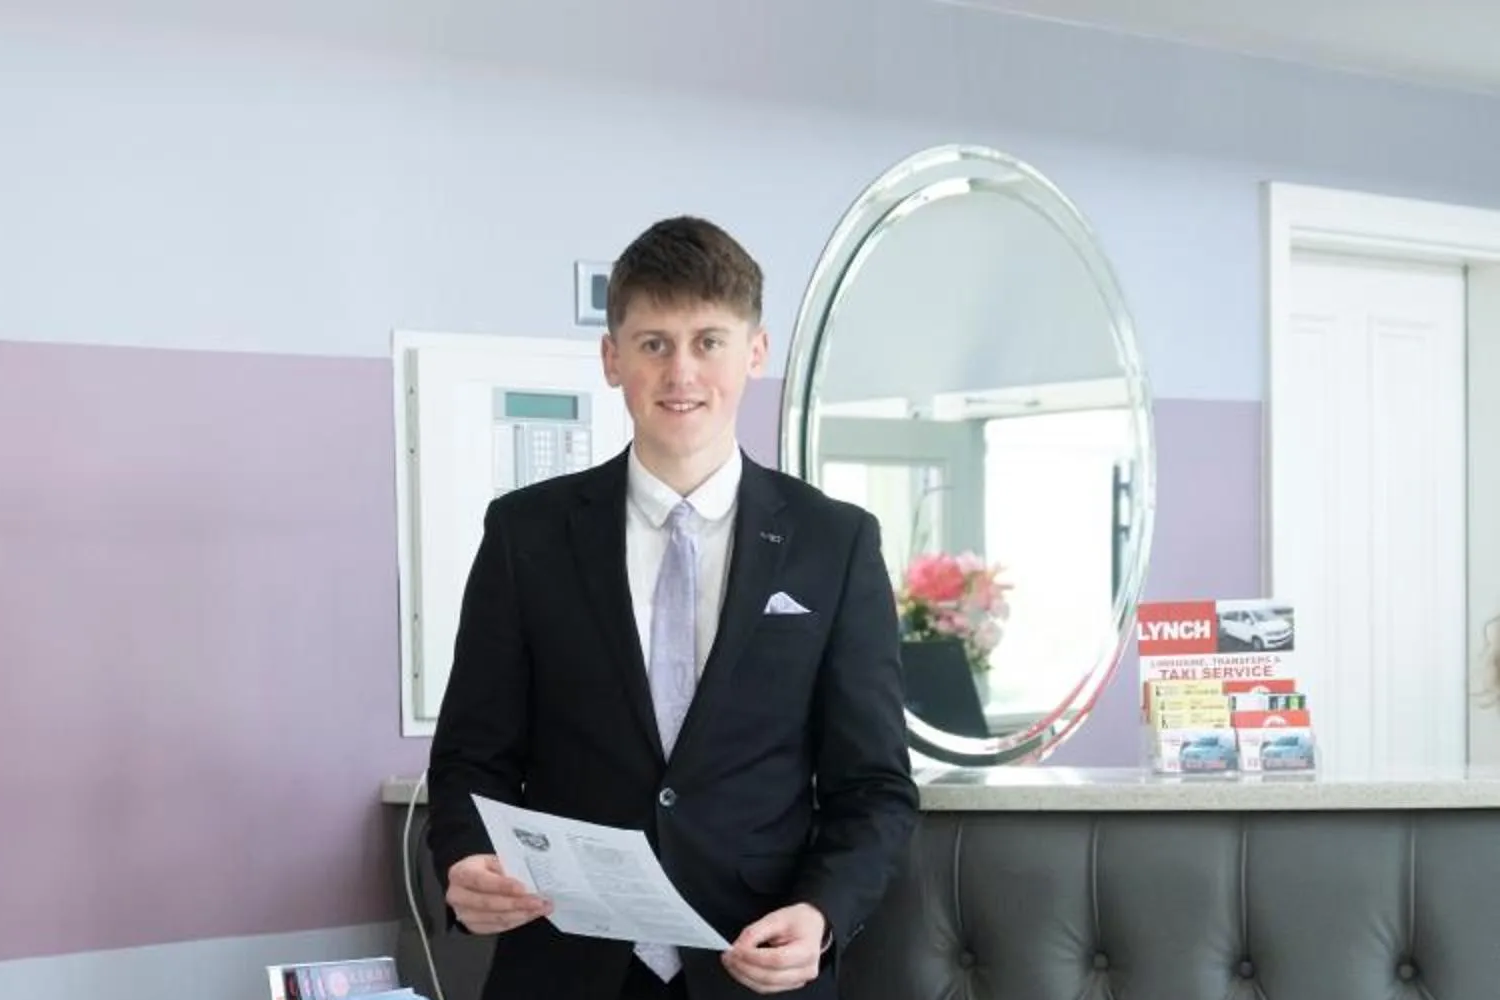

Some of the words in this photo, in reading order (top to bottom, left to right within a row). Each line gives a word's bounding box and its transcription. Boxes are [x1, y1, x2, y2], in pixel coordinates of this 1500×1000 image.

[1138, 619, 1212, 641] LYNCH
[1157, 668, 1197, 681] TAXI
[1201, 665, 1275, 680] SERVICE
